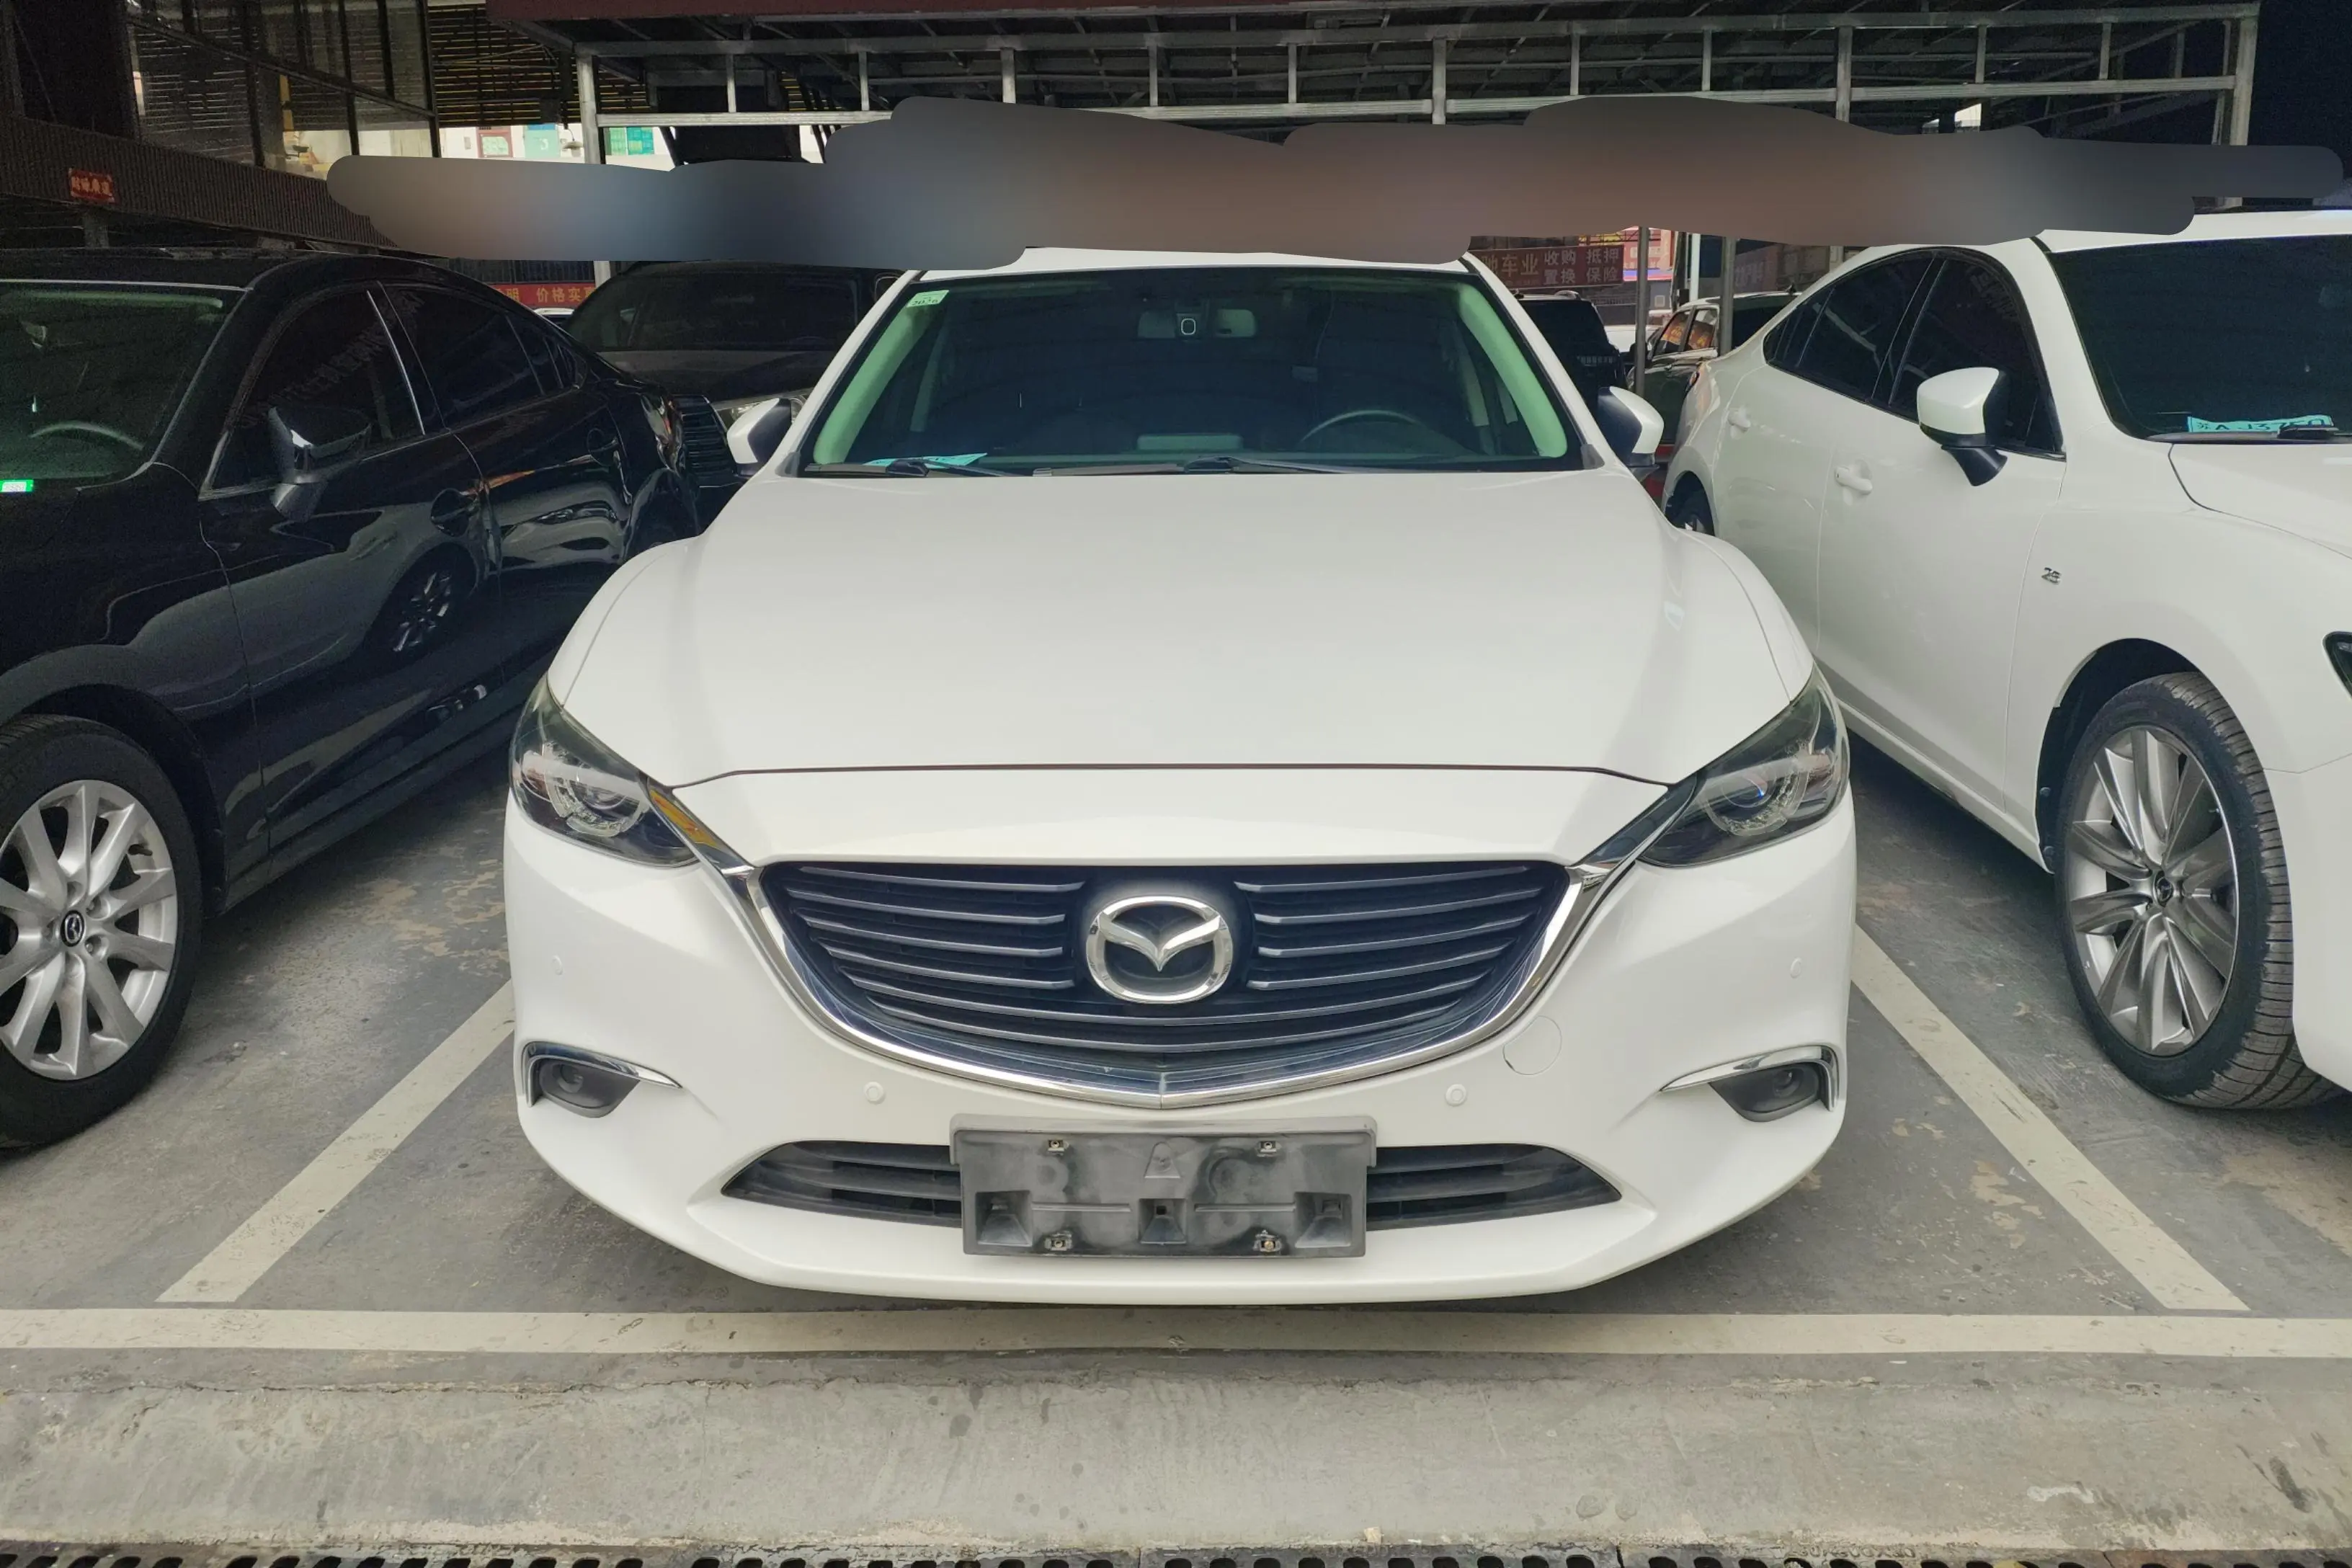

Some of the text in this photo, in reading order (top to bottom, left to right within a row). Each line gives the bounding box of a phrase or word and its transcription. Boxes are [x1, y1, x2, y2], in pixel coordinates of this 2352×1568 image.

[1544, 251, 1576, 266] 收购
[1586, 248, 1619, 264] 抵押
[1544, 268, 1576, 285] 置换
[1586, 266, 1618, 283] 保险
